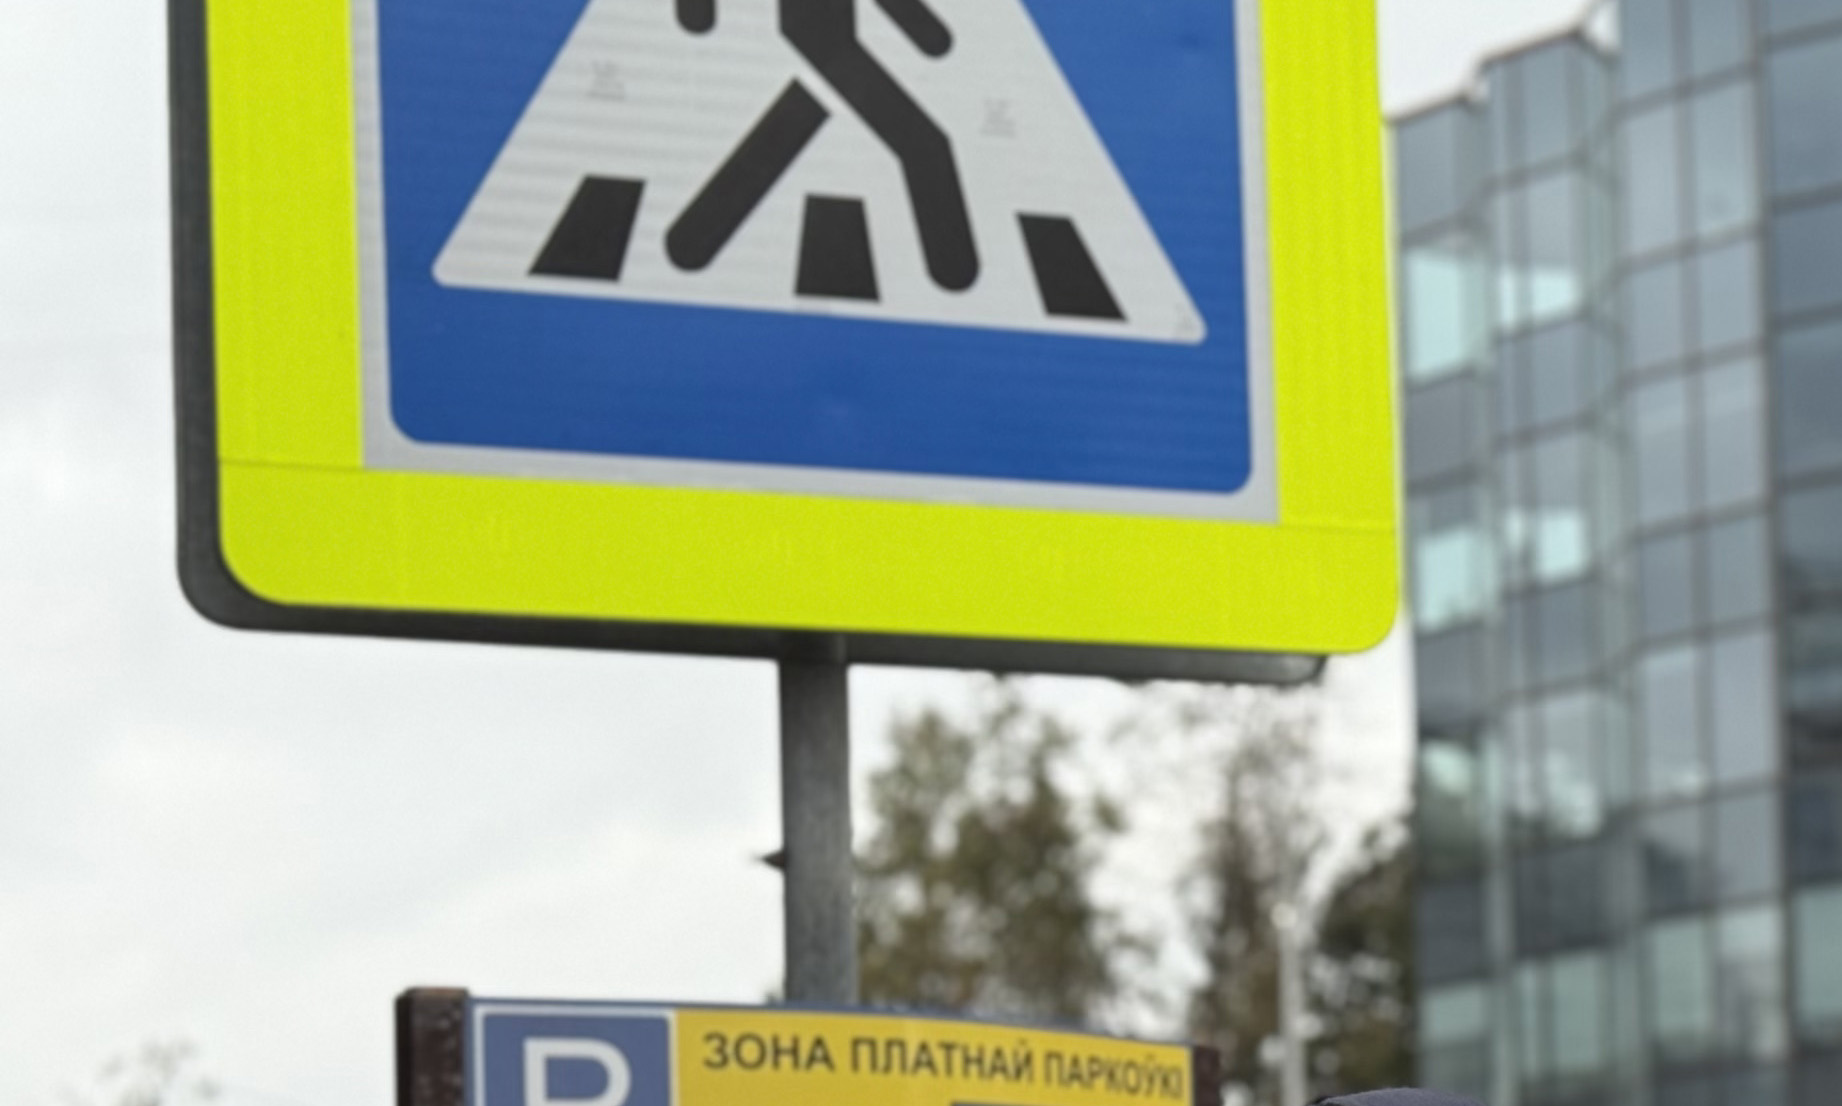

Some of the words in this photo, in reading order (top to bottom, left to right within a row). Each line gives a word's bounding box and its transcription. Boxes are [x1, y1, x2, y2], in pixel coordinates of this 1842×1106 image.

[703, 1032, 834, 1072] ЗОНА
[851, 1036, 1034, 1085] ПЛАТНАЙ
[1044, 1050, 1184, 1101] ПАРКОЎКІ
